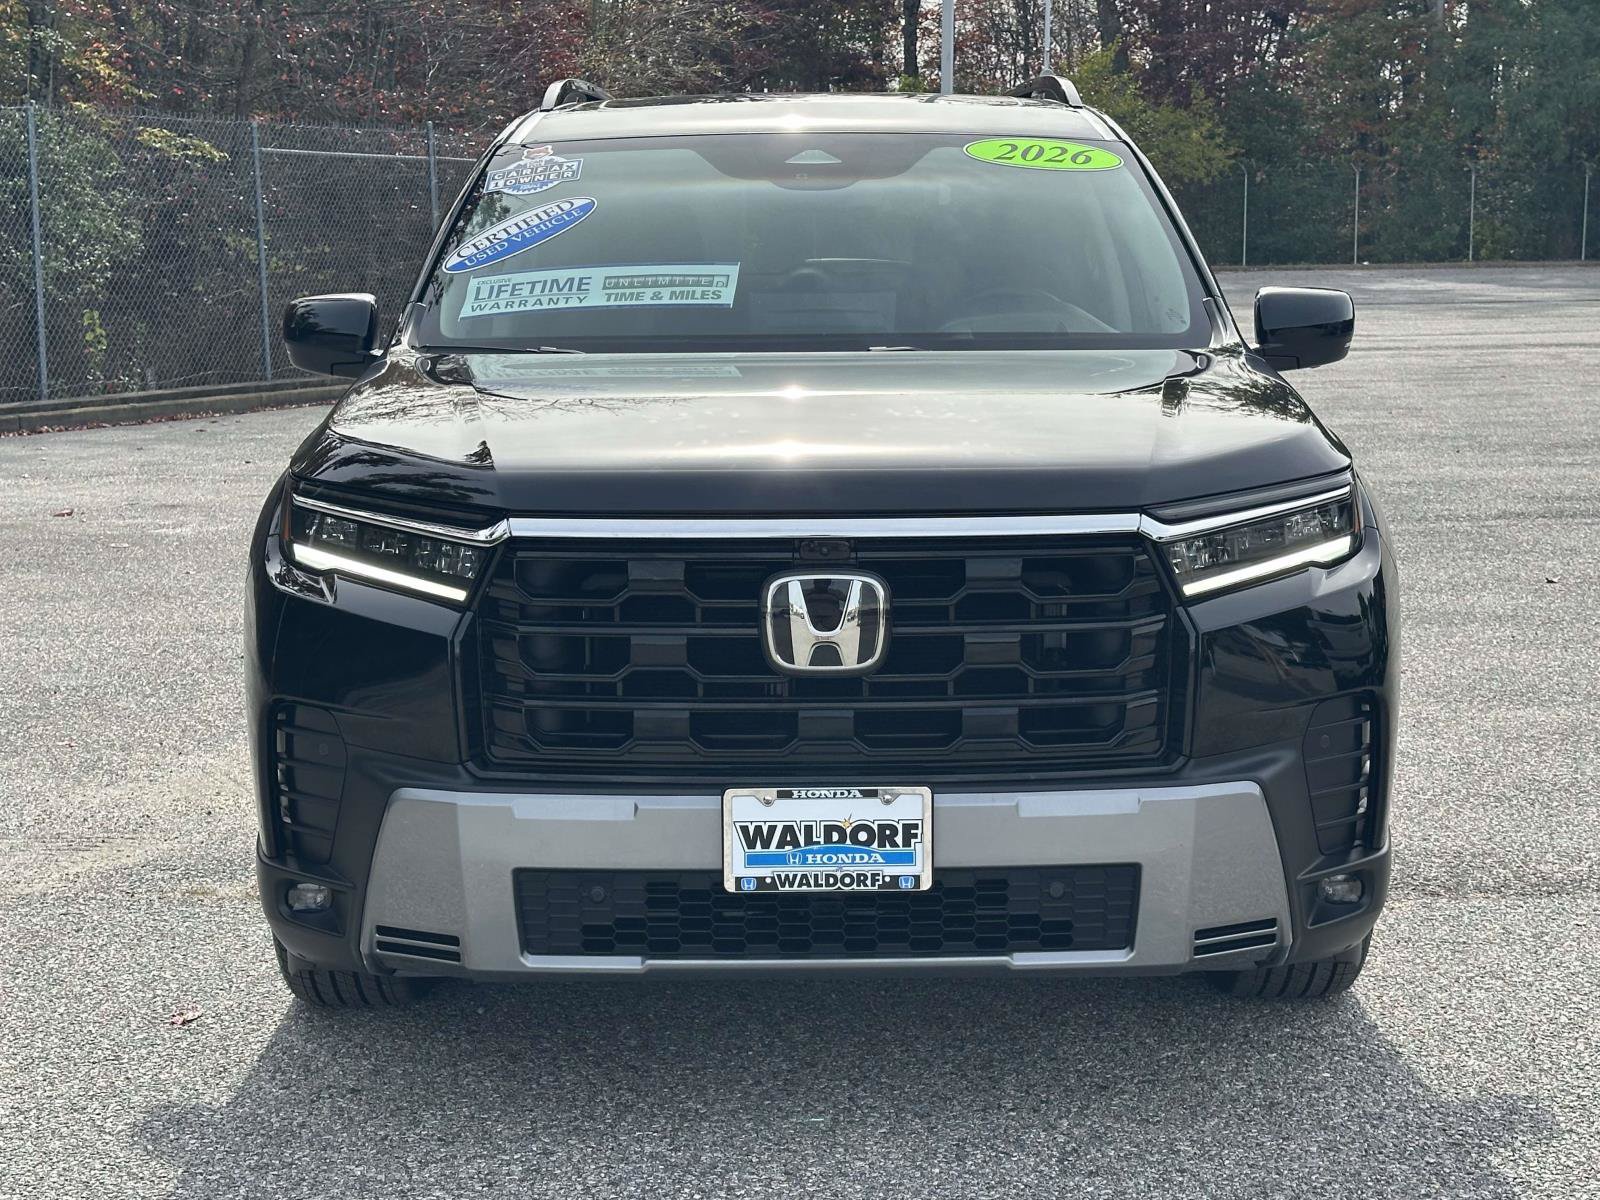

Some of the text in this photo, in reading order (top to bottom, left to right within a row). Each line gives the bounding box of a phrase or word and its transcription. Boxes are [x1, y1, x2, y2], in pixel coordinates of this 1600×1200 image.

[993, 143, 1096, 164] 2026
[506, 171, 573, 186] OWNER
[456, 200, 574, 258] CERTIFIED
[464, 208, 584, 267] USED VEHICLE
[474, 276, 593, 301] LIFETIME
[604, 289, 722, 302] TIME & MILES
[471, 295, 588, 312] WARRANTY
[791, 789, 863, 799] HONDA
[739, 823, 920, 850] WALDORF
[805, 853, 886, 864] HONDA
[775, 873, 881, 889] WALDORF
